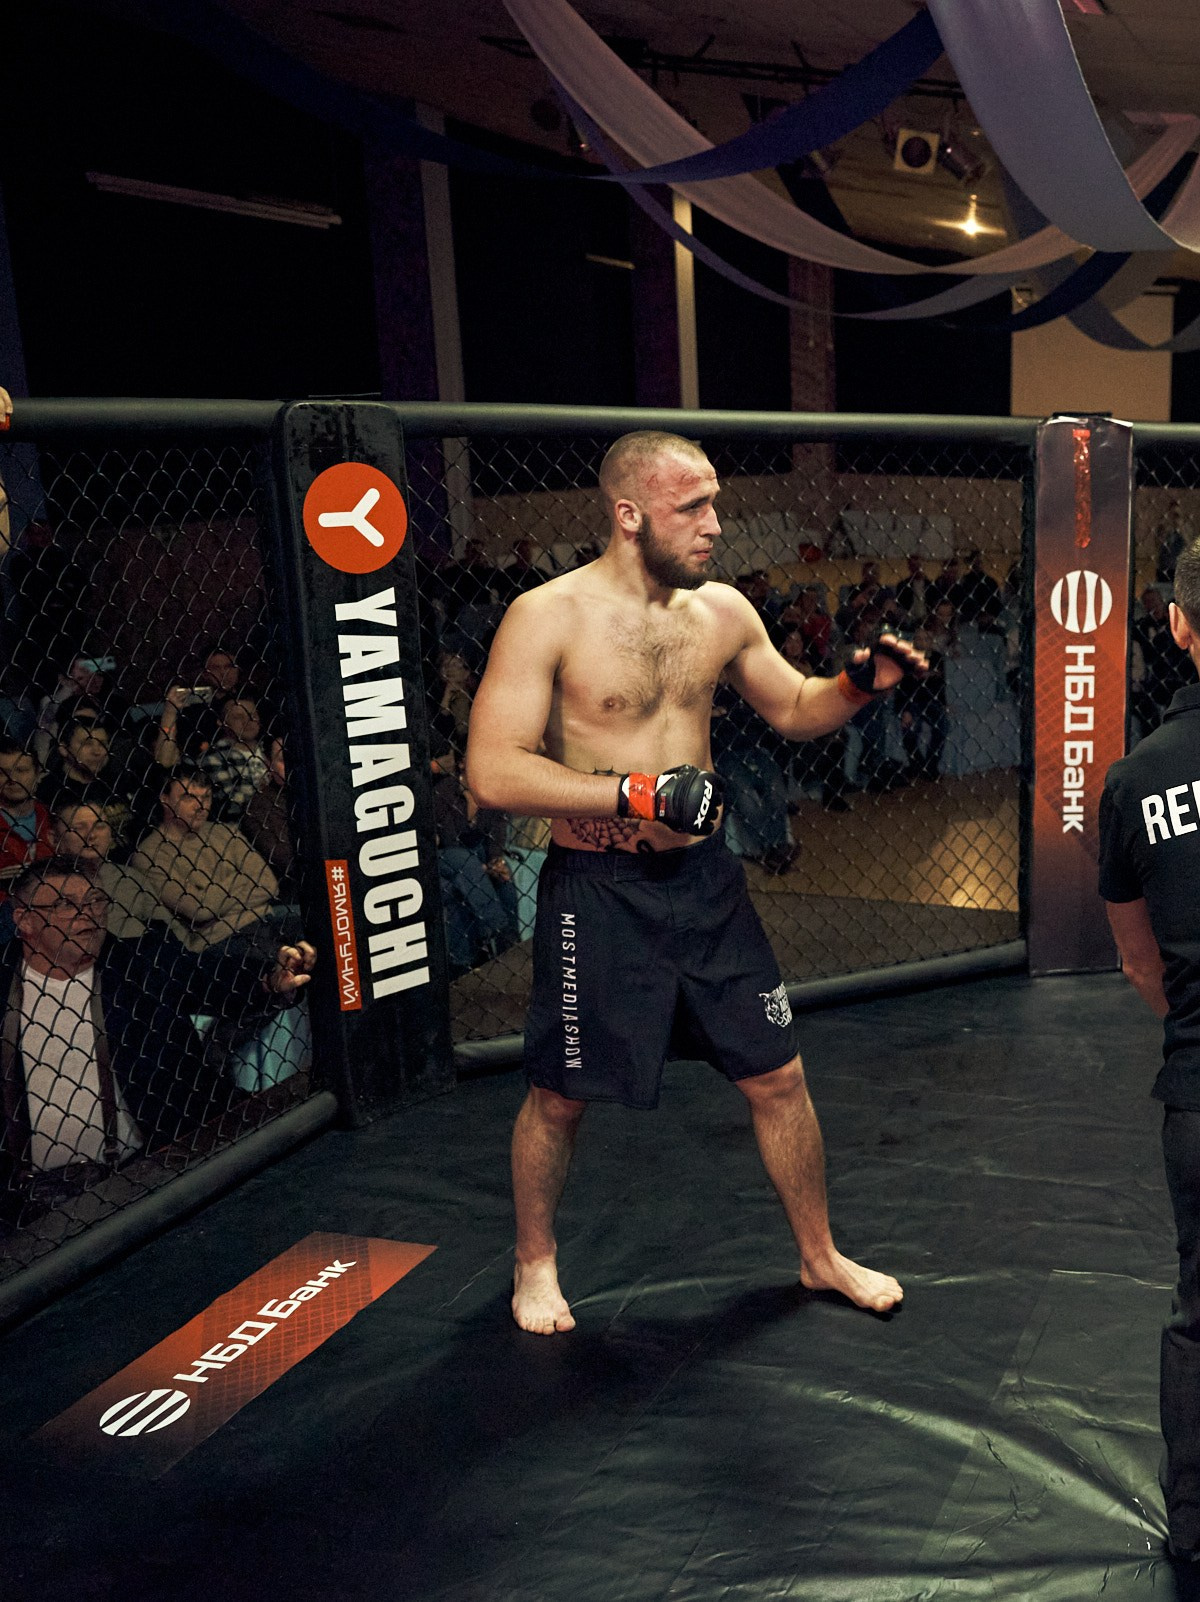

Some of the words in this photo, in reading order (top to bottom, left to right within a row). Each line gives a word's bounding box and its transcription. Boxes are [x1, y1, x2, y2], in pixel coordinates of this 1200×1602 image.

[1064, 645, 1096, 734] НБД
[335, 587, 432, 1000] YAMAGUCHI
[693, 780, 713, 829] RDX
[1063, 741, 1095, 833] Банк
[331, 866, 359, 1005] #ЯМОГУЧИЙ
[172, 1320, 278, 1383] НБД
[257, 1259, 358, 1319] Банк
